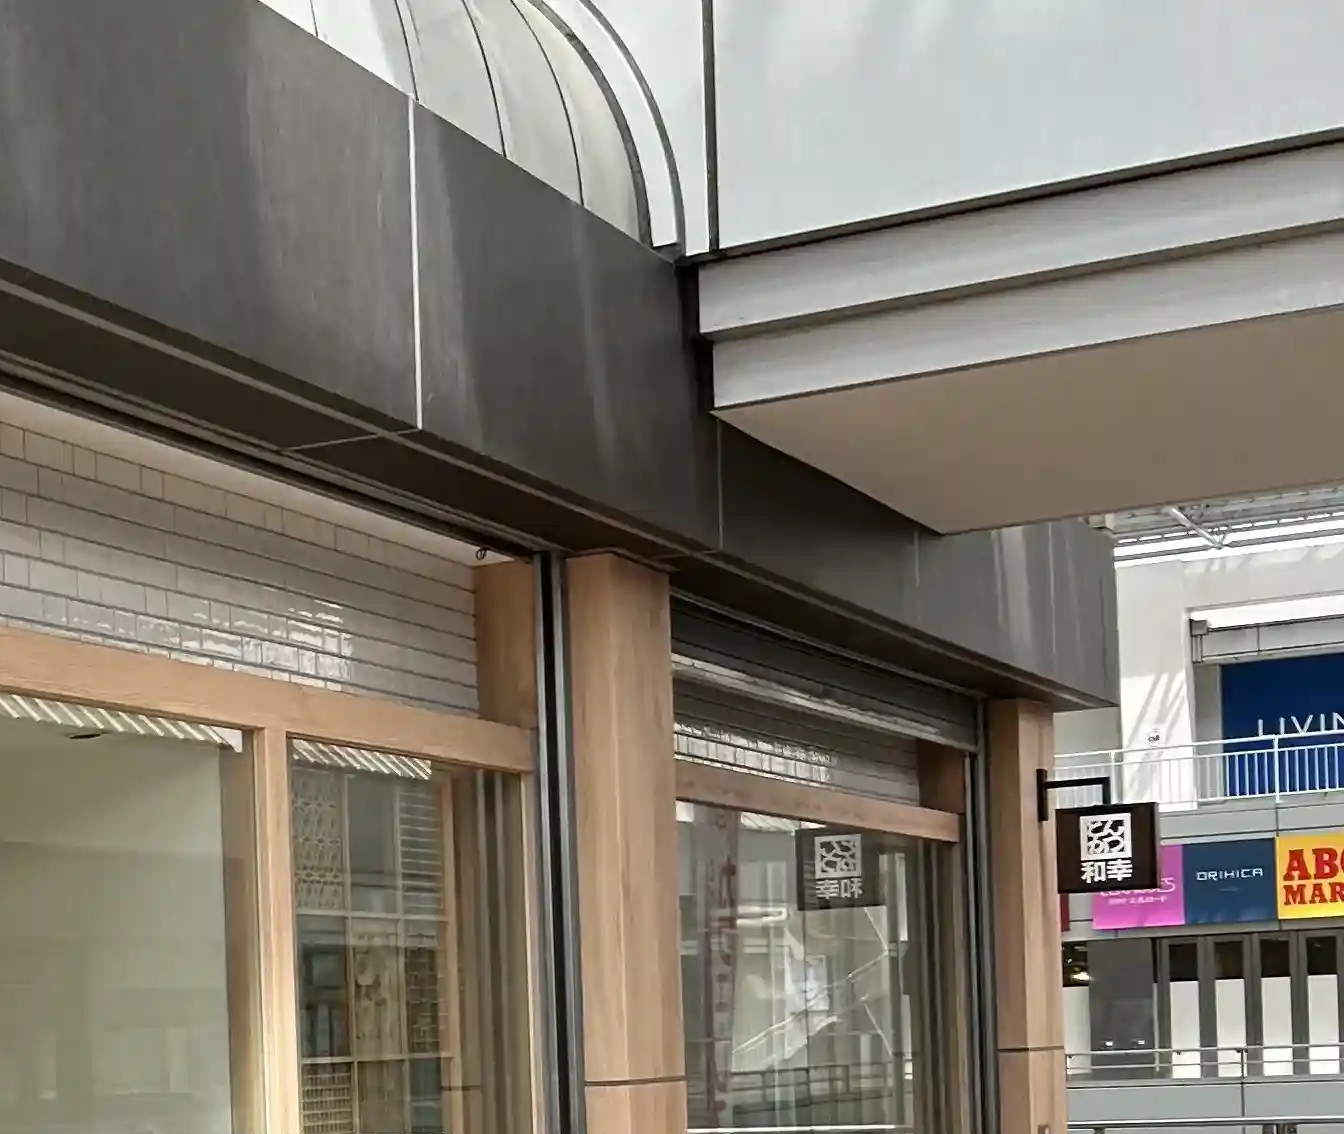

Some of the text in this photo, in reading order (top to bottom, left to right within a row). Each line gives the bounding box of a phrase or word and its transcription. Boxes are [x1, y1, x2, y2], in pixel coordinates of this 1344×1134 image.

[1081, 859, 1133, 884] 和幸
[1197, 867, 1263, 882] ORIHICA
[1283, 847, 1344, 881] AB
